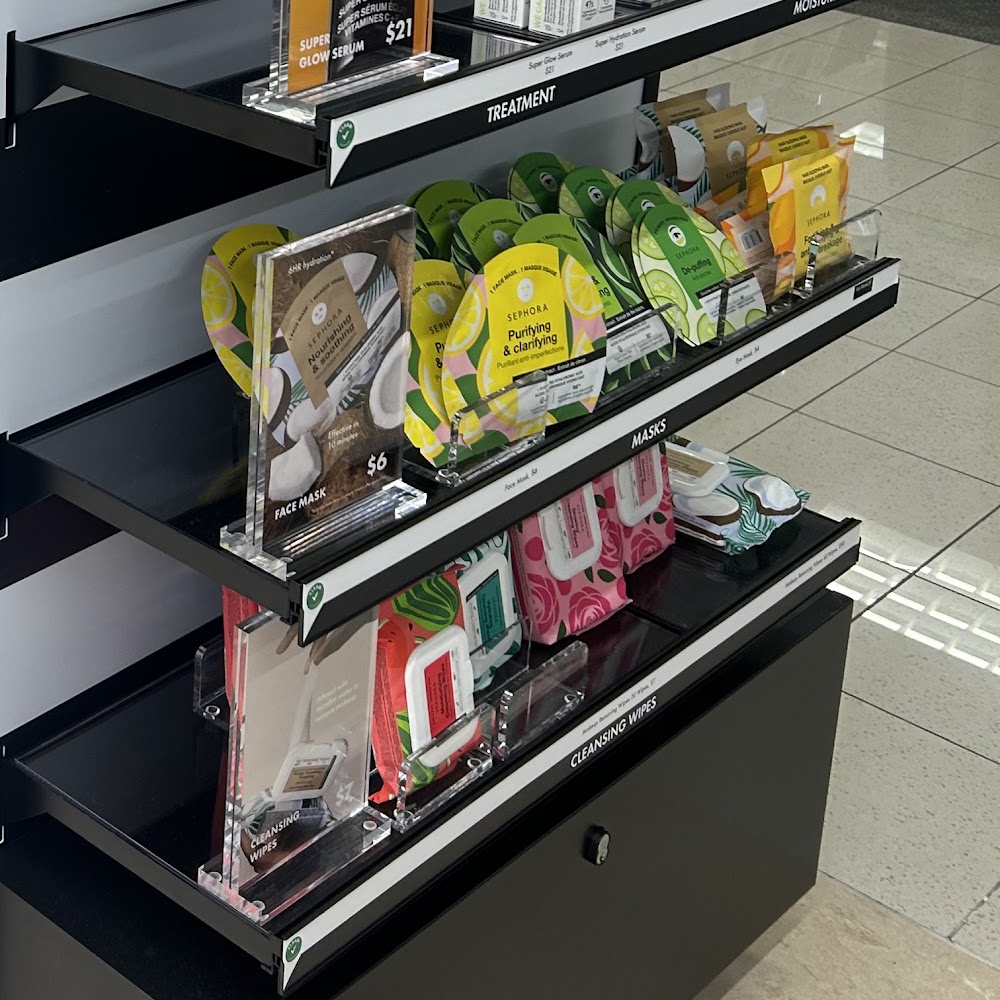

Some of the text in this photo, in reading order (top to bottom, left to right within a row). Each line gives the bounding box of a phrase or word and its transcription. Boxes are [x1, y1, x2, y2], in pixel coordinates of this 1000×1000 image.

[336, 9, 360, 34] SUPER
[478, 3, 486, 16] WE
[534, 15, 541, 28] WE
[344, 13, 384, 37] VITAMINES
[385, 17, 412, 45] $21
[300, 33, 331, 52] SUPER
[595, 27, 646, 48] Super Hydration Serum
[299, 39, 365, 68] GLOW SERUM
[528, 50, 573, 71] Super Glow Serum
[545, 67, 555, 76] $21
[486, 85, 557, 124] TREATMENT
[493, 278, 504, 290] FACE
[504, 269, 517, 281] MASK
[507, 303, 549, 322] SEPHORA
[307, 314, 352, 366] Nourishing
[308, 307, 343, 349] SEPHORA
[508, 320, 551, 341] Purifying
[312, 322, 356, 375] & soothing
[503, 333, 559, 356] & clarifying
[496, 345, 565, 370] Purifiant anti-imperfections
[735, 355, 743, 364] Eye
[327, 421, 360, 440] Effective in
[328, 432, 359, 450] 10 minutes
[631, 418, 667, 449] MASKS
[367, 451, 388, 476] $6
[504, 480, 516, 492] Face
[274, 487, 327, 520] FACE MASK
[570, 696, 657, 768] CLEANSING WIPES
[250, 810, 300, 849] CLEANSING
[249, 839, 278, 864] WIPES
